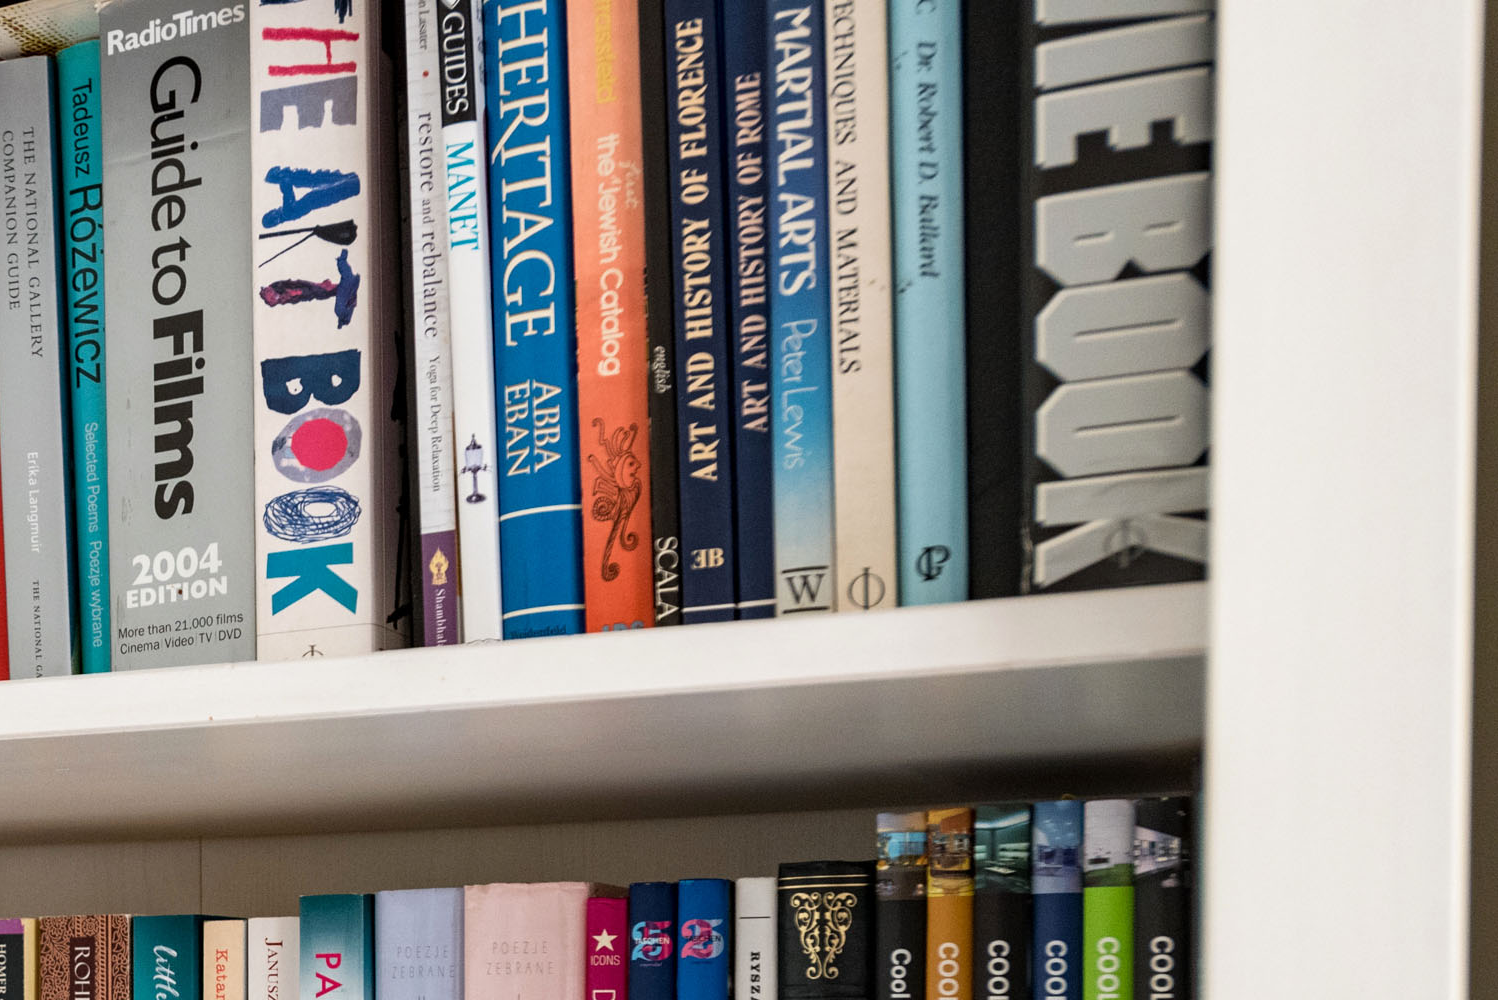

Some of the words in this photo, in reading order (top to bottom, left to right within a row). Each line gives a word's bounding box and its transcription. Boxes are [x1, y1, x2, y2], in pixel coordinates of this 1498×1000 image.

[107, 6, 245, 55] RadioTimes
[443, 12, 469, 114] GUIDES
[71, 79, 93, 179] Tadeusz
[675, 18, 708, 159] FLORENCE
[774, 5, 814, 186] MARTIAL
[23, 127, 34, 163] THE
[150, 56, 202, 230] Guide
[417, 112, 434, 191] restore
[492, 1, 555, 347] HERITAGE
[598, 133, 619, 176] the
[3, 131, 18, 243] COMPANION
[24, 171, 40, 267] NATIONAL
[446, 141, 482, 251] MANET
[598, 182, 622, 264] Jewish
[681, 168, 710, 205] OF
[835, 161, 858, 215] AND
[7, 246, 21, 311] GUIDE
[69, 184, 102, 387] Różewicz
[153, 237, 192, 305] to
[421, 230, 439, 338] rebalance
[682, 218, 715, 340] HISTORY
[778, 193, 817, 296] ARTS
[27, 273, 43, 358] GALLERY
[598, 268, 624, 376] Catalog
[835, 228, 861, 375] MATERIALS
[153, 310, 205, 520] Films
[686, 351, 716, 412] AND
[84, 422, 100, 483] Selected
[505, 383, 530, 476] EBAN
[532, 381, 563, 472] ABBA
[690, 423, 720, 481] ART
[87, 486, 100, 532] Poems
[260, 349, 363, 616] BOOK
[88, 541, 103, 589] Poezje
[126, 576, 227, 608] EDITION
[132, 542, 222, 585] 2004
[92, 590, 103, 647] wybrane
[118, 627, 144, 639] More
[148, 624, 171, 635] than
[216, 613, 244, 624] films
[120, 641, 160, 654] Cinema
[164, 636, 194, 648] Video
[199, 632, 212, 643] TV
[218, 628, 241, 641] DVD
[890, 949, 912, 998] Cool
